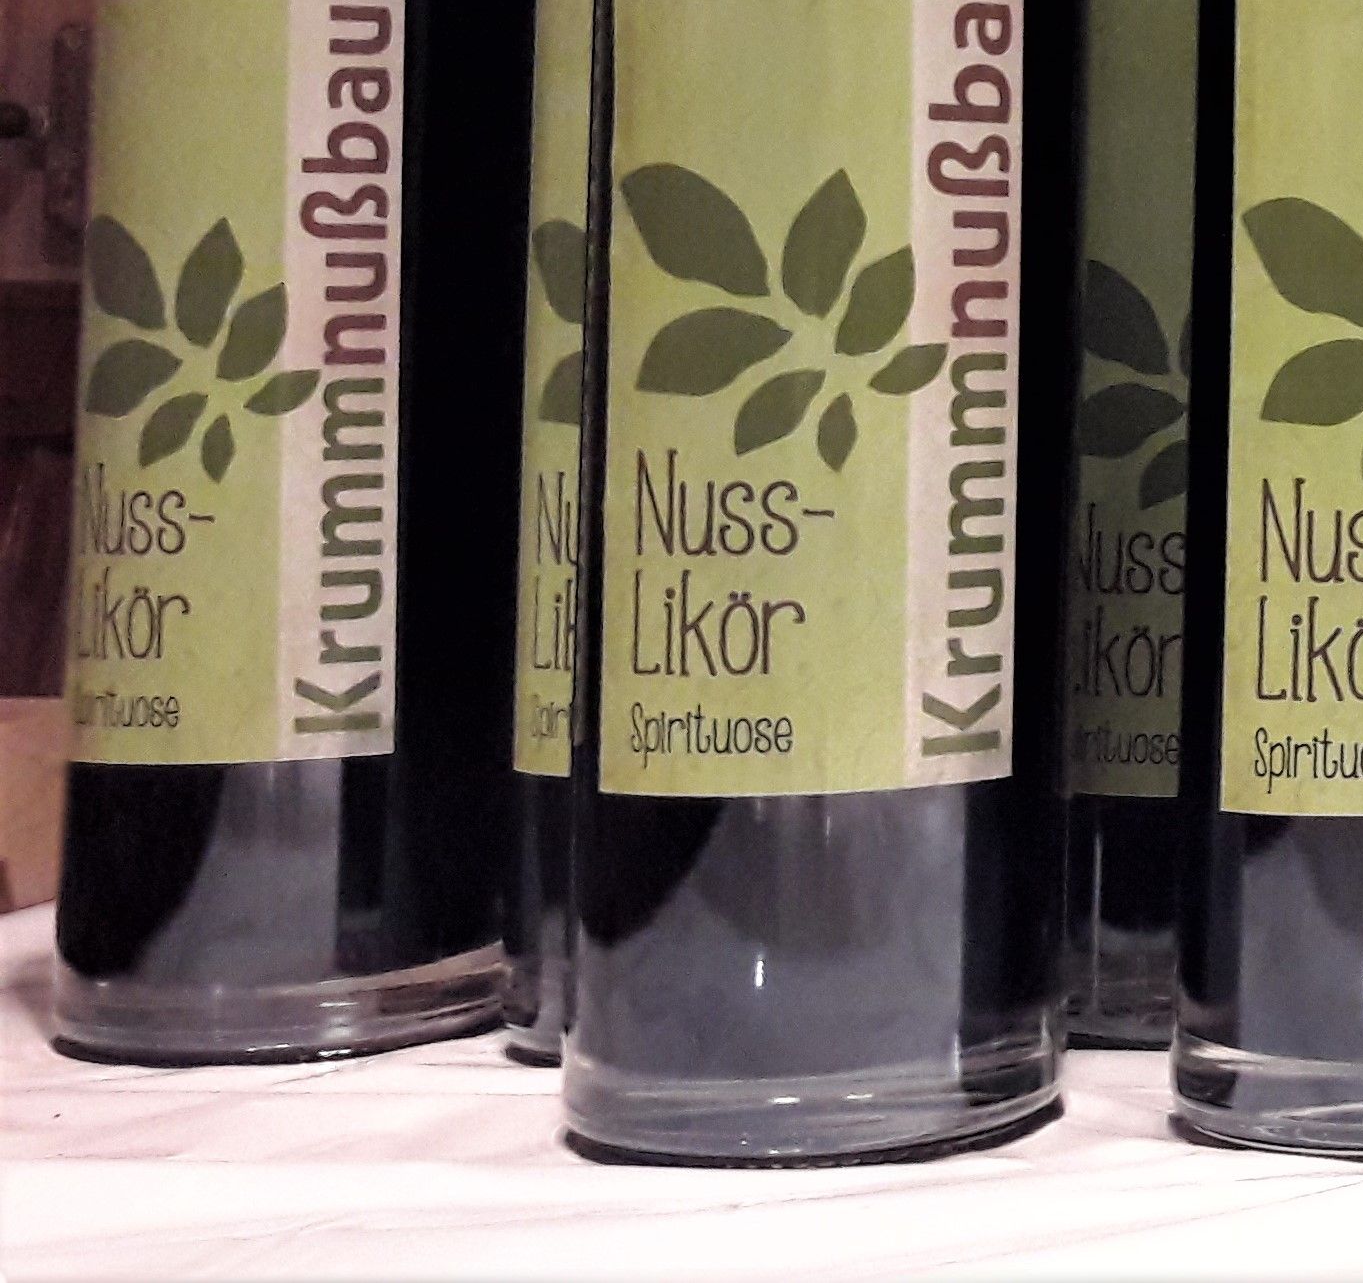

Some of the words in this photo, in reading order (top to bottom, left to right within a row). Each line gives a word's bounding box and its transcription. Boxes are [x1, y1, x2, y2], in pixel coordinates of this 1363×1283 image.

[635, 448, 835, 557] Nuss-
[631, 569, 806, 678] Likör
[631, 702, 793, 769] Spirituose
